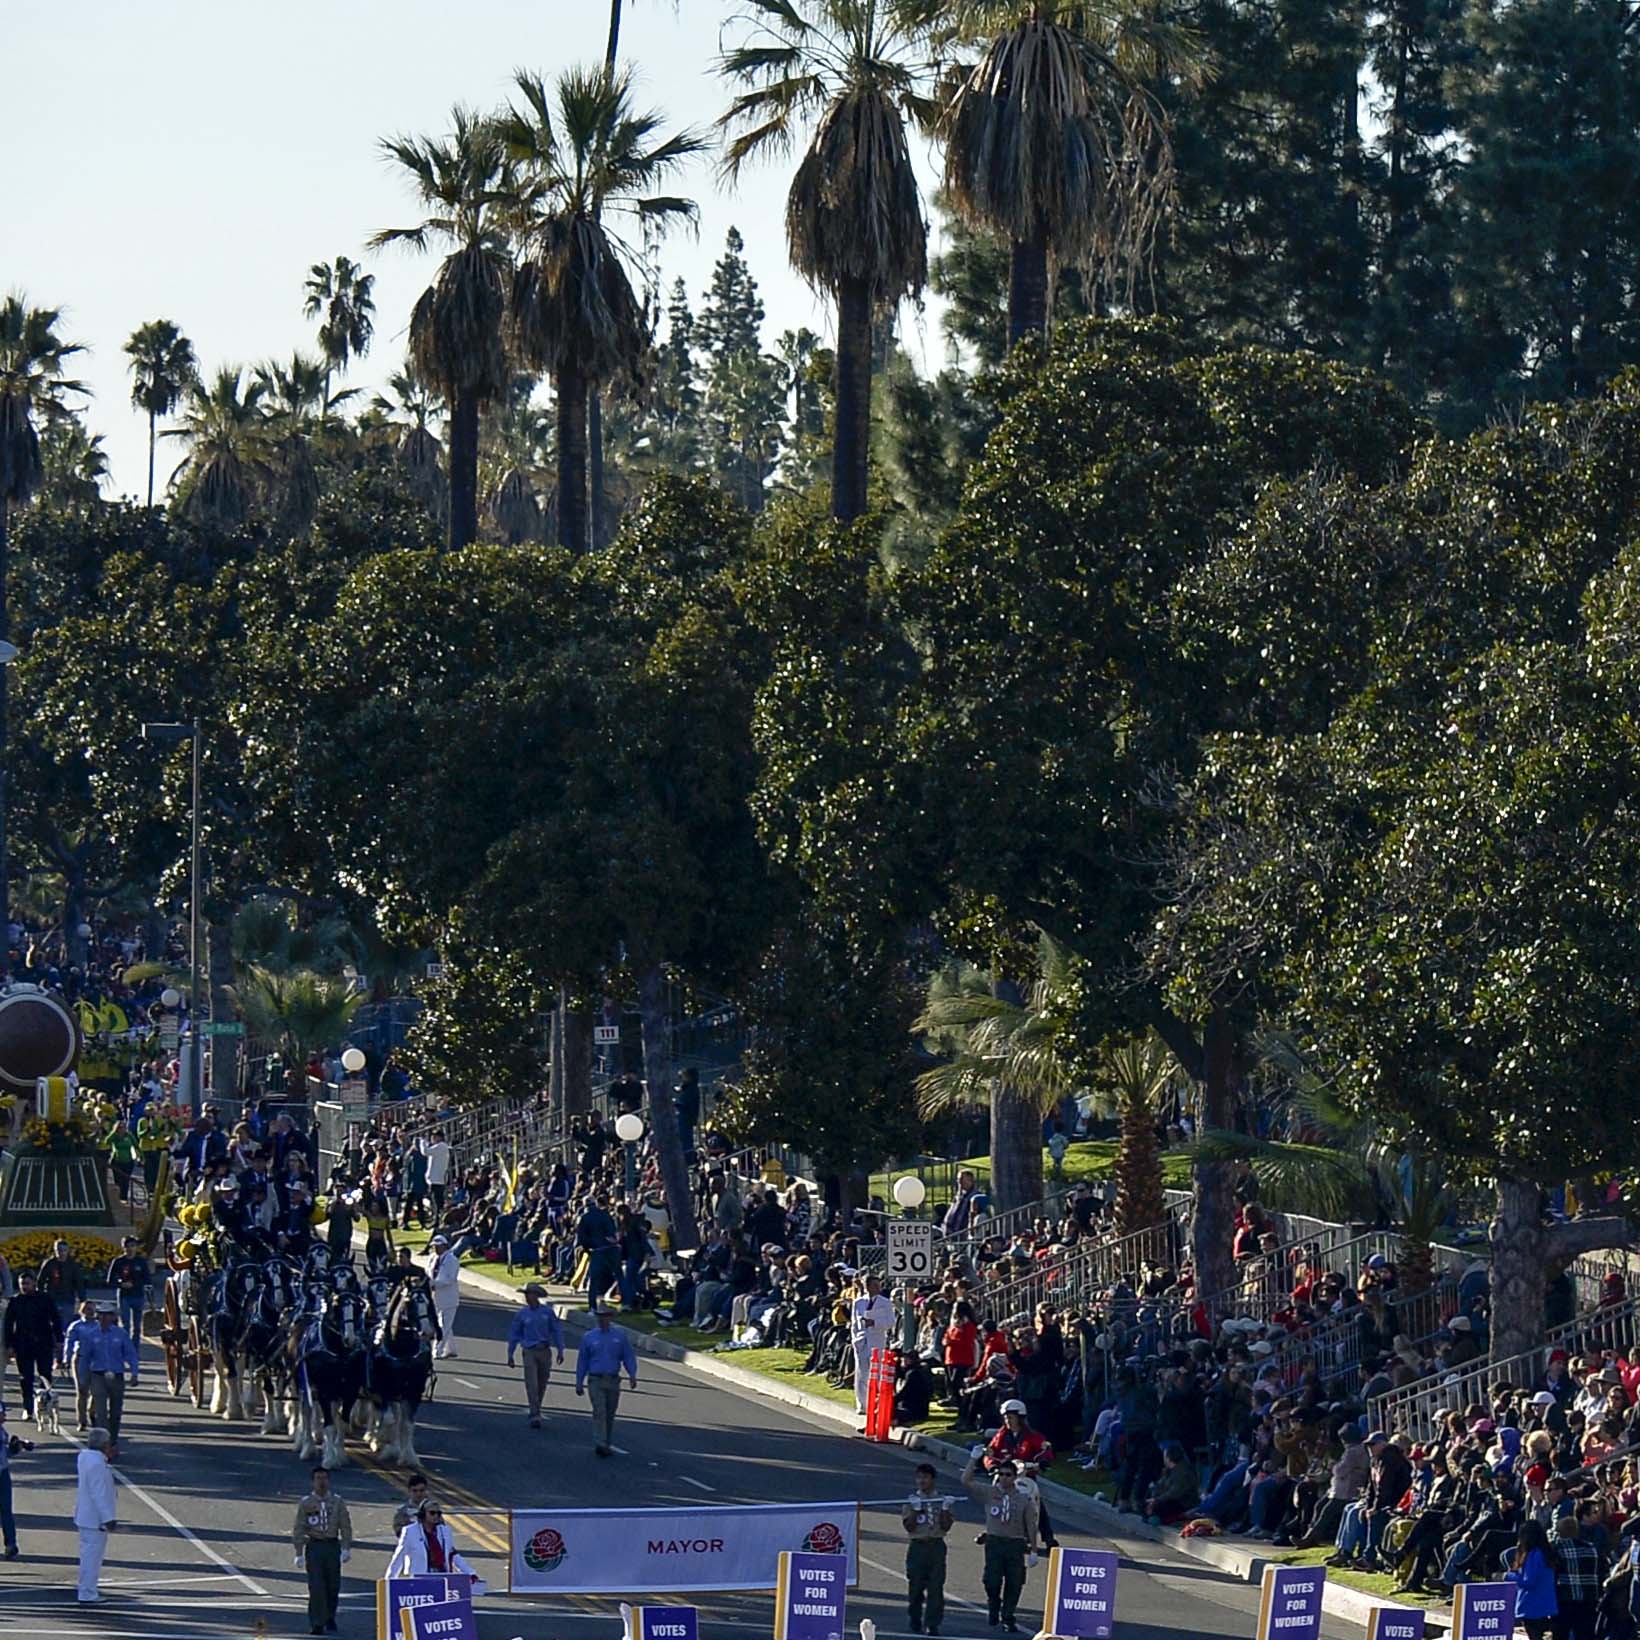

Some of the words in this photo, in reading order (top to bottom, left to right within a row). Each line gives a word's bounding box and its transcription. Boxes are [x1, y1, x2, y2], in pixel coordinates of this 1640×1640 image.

[890, 1225, 929, 1236] SPEED
[893, 1239, 926, 1249] LIMIT
[892, 1252, 927, 1272] 30
[647, 1538, 724, 1555] MAYOR
[800, 1569, 835, 1582] VOTES
[1070, 1565, 1106, 1578] VOTES
[805, 1588, 828, 1600] FOR
[1075, 1582, 1098, 1594] FOR
[1282, 1582, 1314, 1595] VOTES
[398, 1595, 434, 1607] VOTES
[1063, 1598, 1106, 1612] WOMEN
[1286, 1599, 1306, 1611] FOR
[1472, 1600, 1506, 1612] VOTES
[793, 1604, 837, 1617] WOMEN
[424, 1618, 462, 1634] VOTES
[1274, 1615, 1314, 1628] WOMEN
[1478, 1618, 1498, 1629] FOR
[652, 1624, 686, 1637] VOTES
[1384, 1625, 1414, 1638] VOTES
